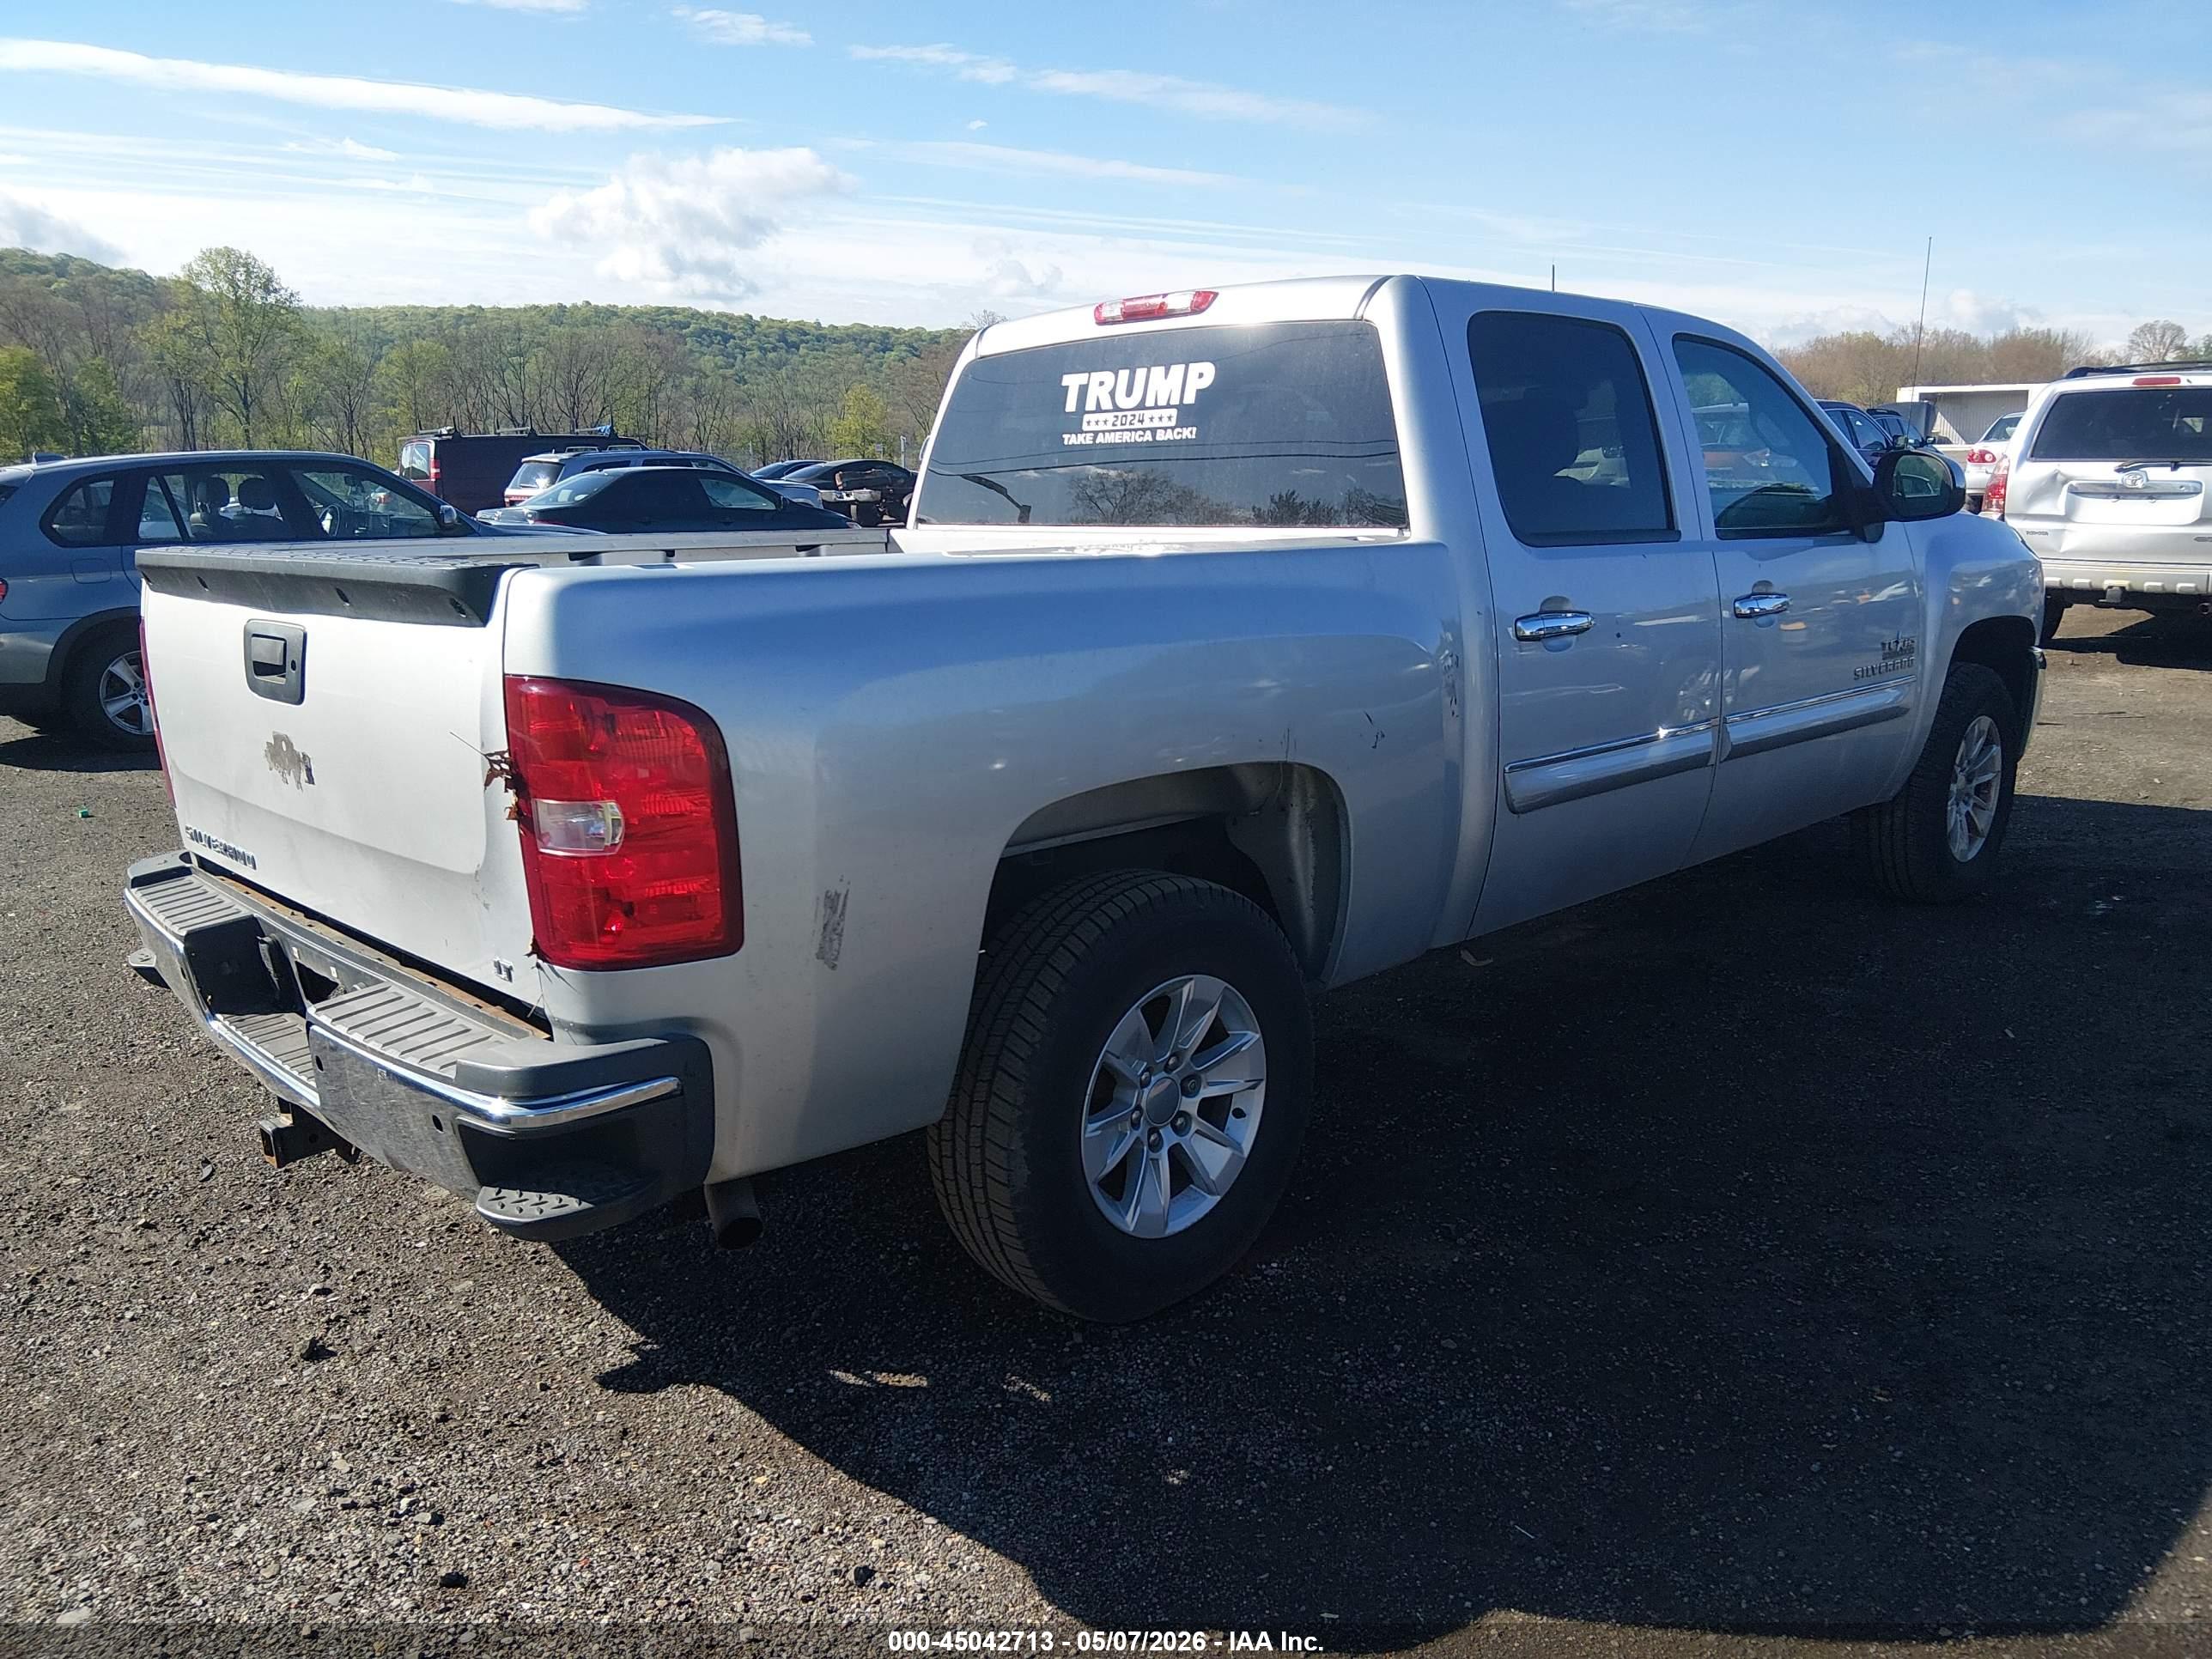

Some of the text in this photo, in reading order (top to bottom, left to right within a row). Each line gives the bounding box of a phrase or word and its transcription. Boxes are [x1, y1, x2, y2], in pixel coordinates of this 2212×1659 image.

[1061, 362, 1216, 413] TRUMP
[1111, 412, 1146, 428] 2024
[1062, 427, 1197, 446] TAKE AMERICA BACK!
[494, 958, 514, 983] LT
